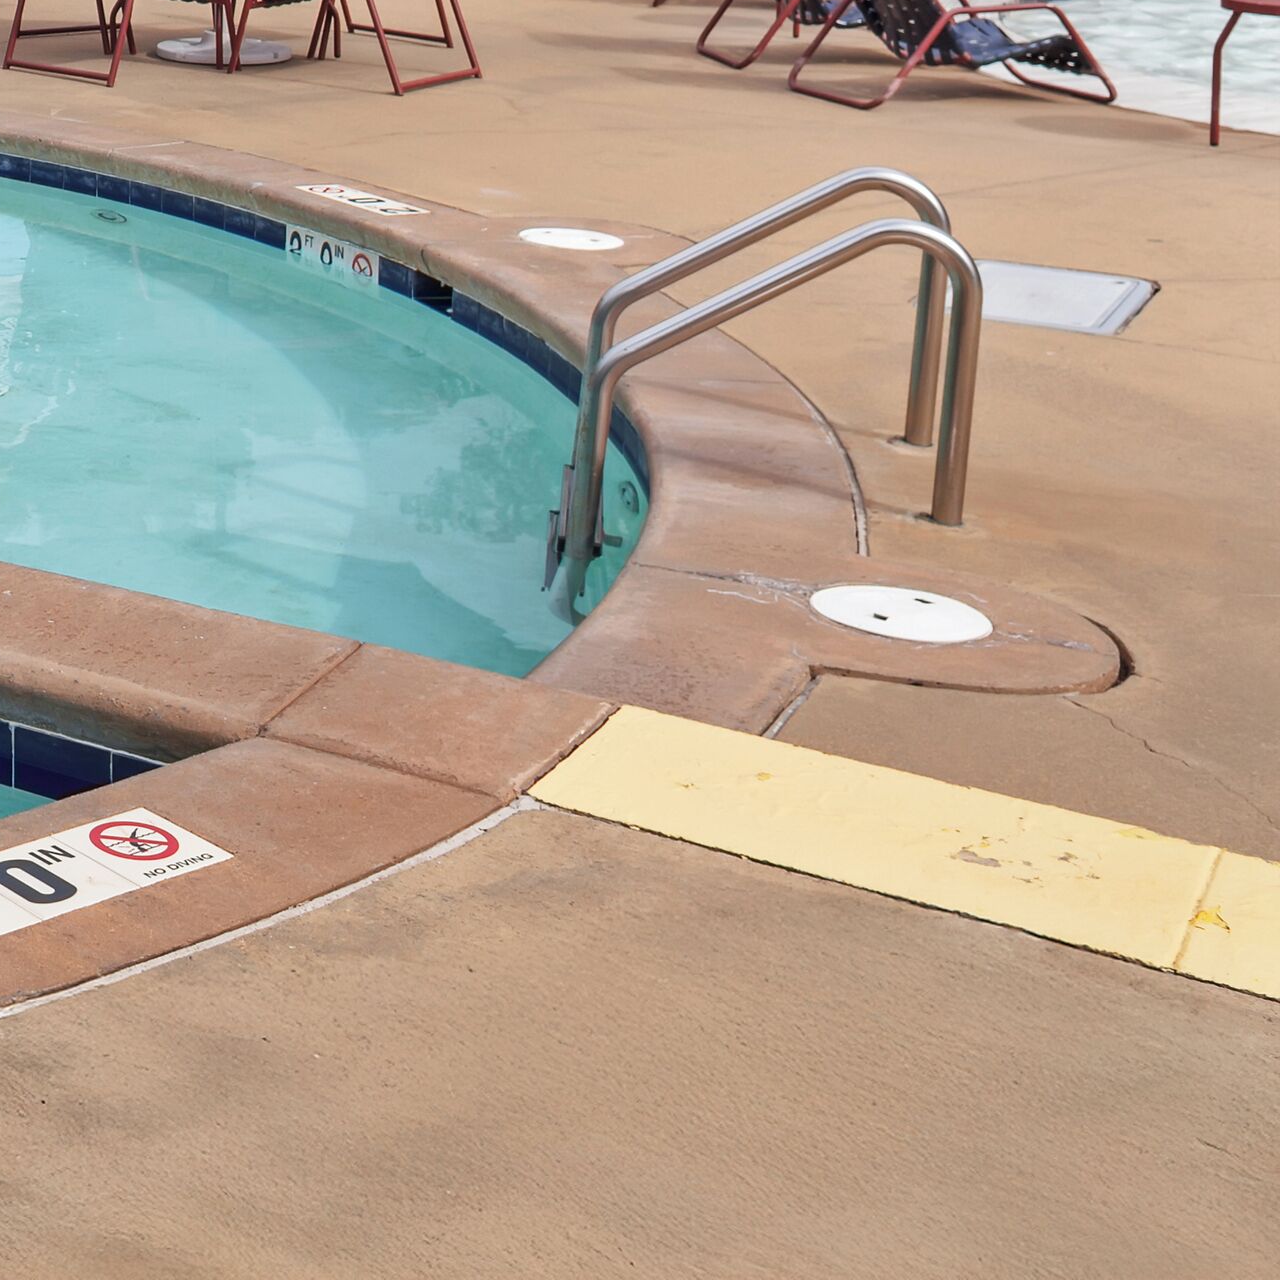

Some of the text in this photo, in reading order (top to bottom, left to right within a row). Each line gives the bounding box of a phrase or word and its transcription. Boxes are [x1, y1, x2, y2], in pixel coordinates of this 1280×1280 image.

[304, 234, 314, 248] FT
[320, 241, 333, 265] 0
[334, 244, 345, 260] IN
[28, 844, 77, 867] IN
[143, 852, 215, 879] NO DIVING
